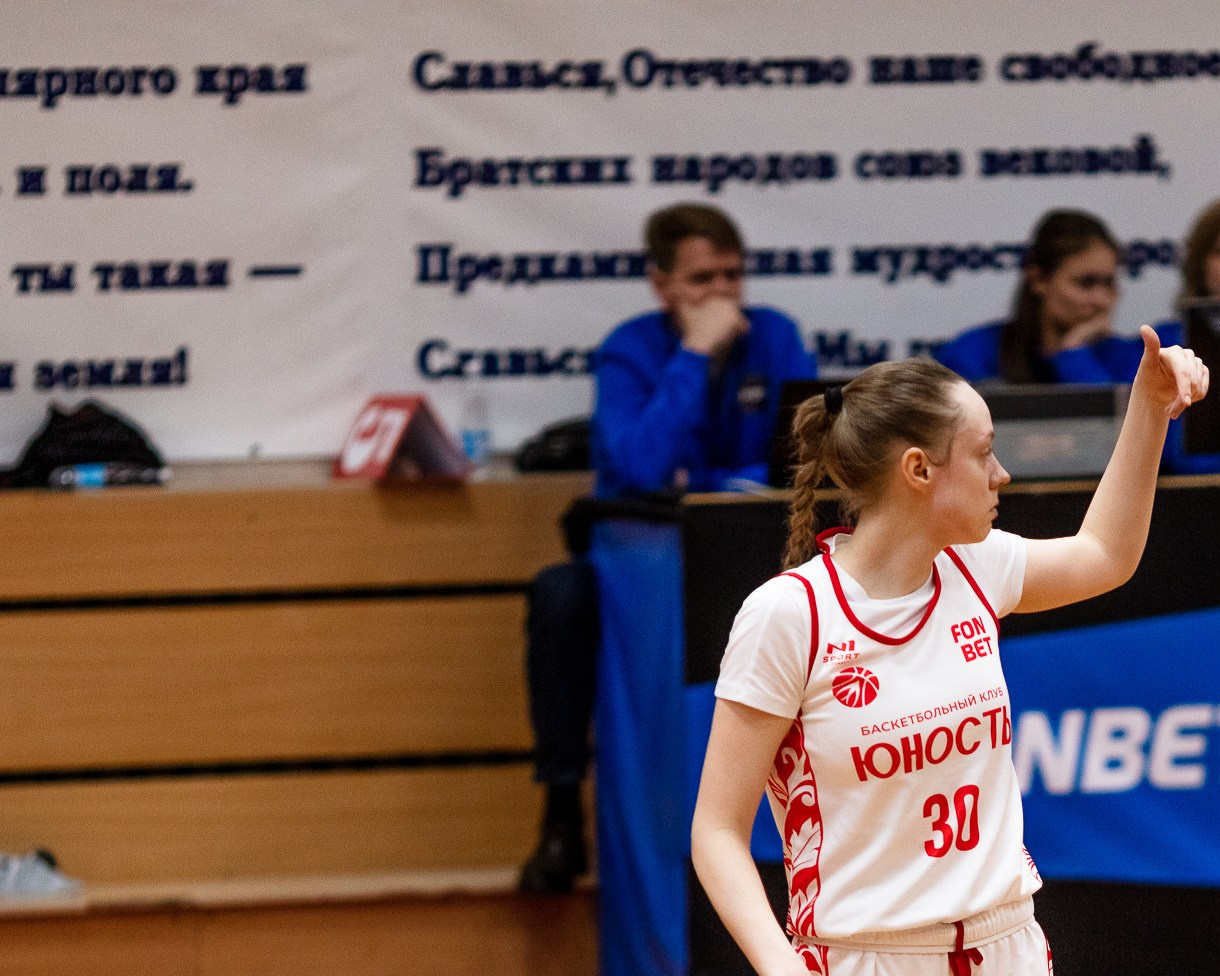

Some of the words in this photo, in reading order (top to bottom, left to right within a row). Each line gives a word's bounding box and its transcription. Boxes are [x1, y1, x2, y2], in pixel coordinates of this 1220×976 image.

[195, 64, 308, 106] края
[652, 153, 838, 192] народов
[12, 262, 75, 293] ты
[91, 258, 231, 292] такая
[951, 616, 986, 643] FON
[961, 637, 993, 662] BET
[861, 694, 977, 736] БАСКЕТБОЛЬНЫЙ
[979, 687, 1004, 704] КЛУБ
[850, 705, 1012, 782] ЮНОСТЬ
[922, 784, 980, 859] 30
